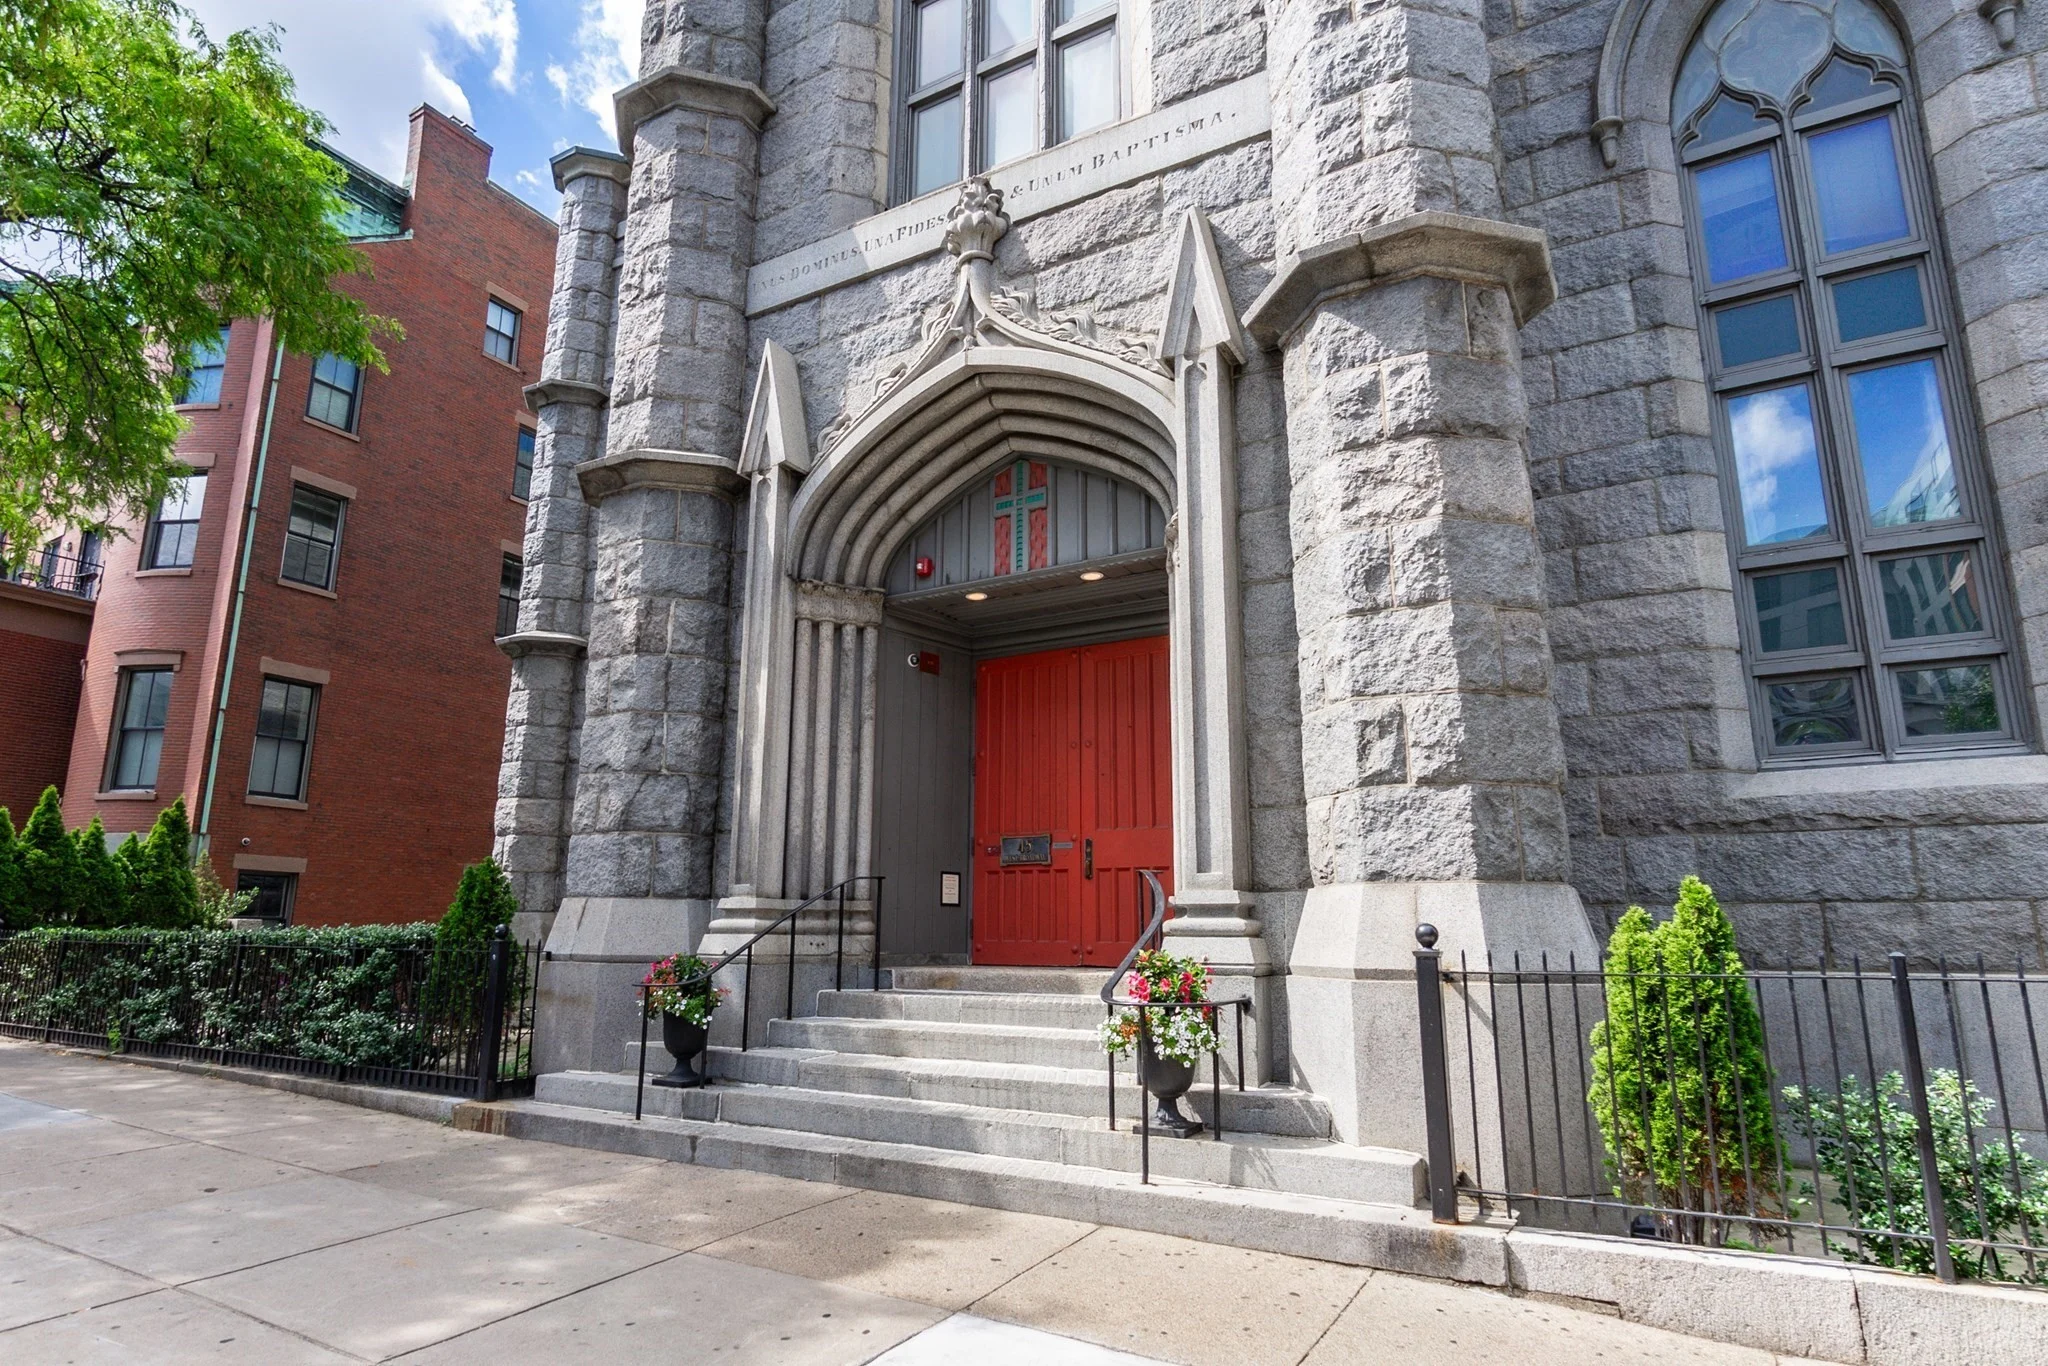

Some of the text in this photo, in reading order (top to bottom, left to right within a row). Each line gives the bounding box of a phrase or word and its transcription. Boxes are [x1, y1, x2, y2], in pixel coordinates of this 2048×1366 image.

[864, 233, 894, 252] UNA
[1010, 185, 1024, 199] &
[1029, 164, 1083, 191] UNUM
